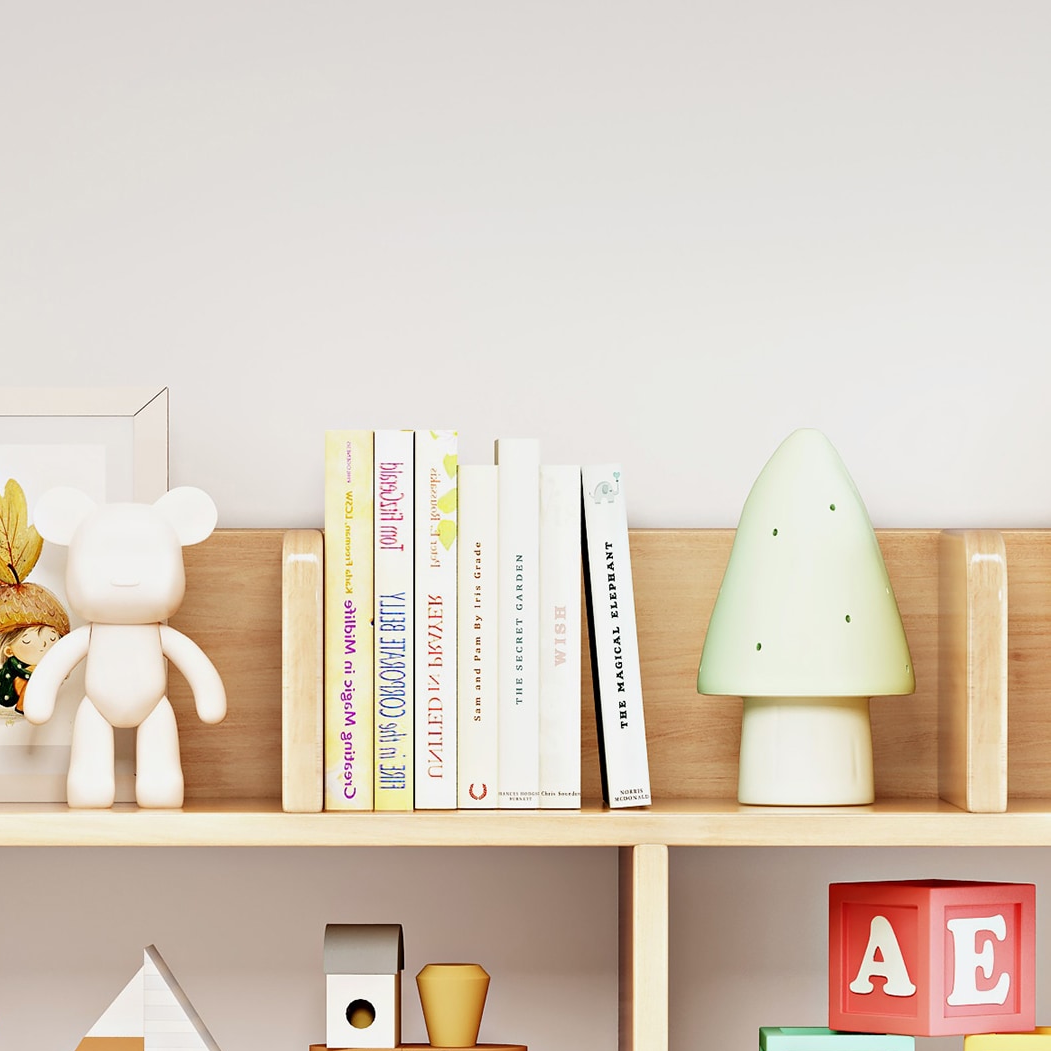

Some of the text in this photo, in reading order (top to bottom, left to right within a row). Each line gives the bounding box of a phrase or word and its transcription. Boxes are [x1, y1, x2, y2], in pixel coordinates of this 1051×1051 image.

[473, 541, 483, 723] Sam and Pam By Iris Grade
[515, 553, 524, 706] THE SECRET GARDEN
[553, 605, 567, 668] WISH
[604, 541, 630, 730] THE MAGICAL ELEPHANT
[849, 915, 917, 998] A
[946, 914, 1011, 1007] E
